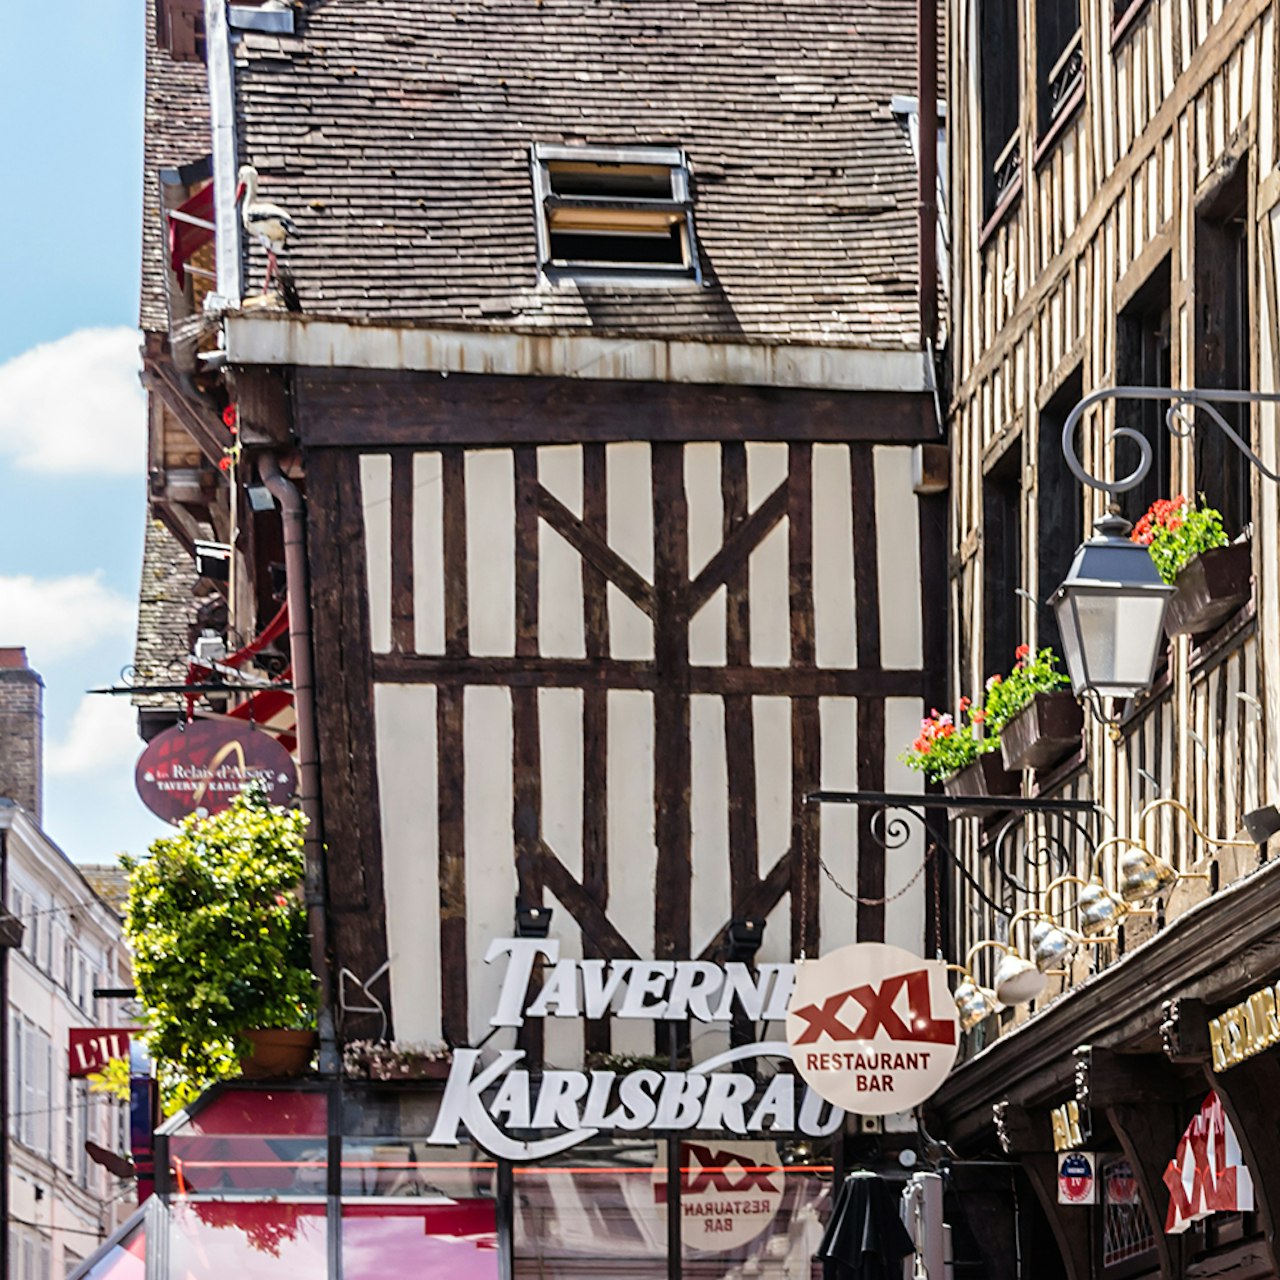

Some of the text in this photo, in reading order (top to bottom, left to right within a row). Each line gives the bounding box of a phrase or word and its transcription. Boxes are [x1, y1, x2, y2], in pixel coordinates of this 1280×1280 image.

[172, 764, 214, 779] Relais
[793, 969, 957, 1045] XXL
[806, 1053, 931, 1072] RESTAURANT
[856, 1073, 895, 1093] BAR
[1050, 1100, 1083, 1152] BAR
